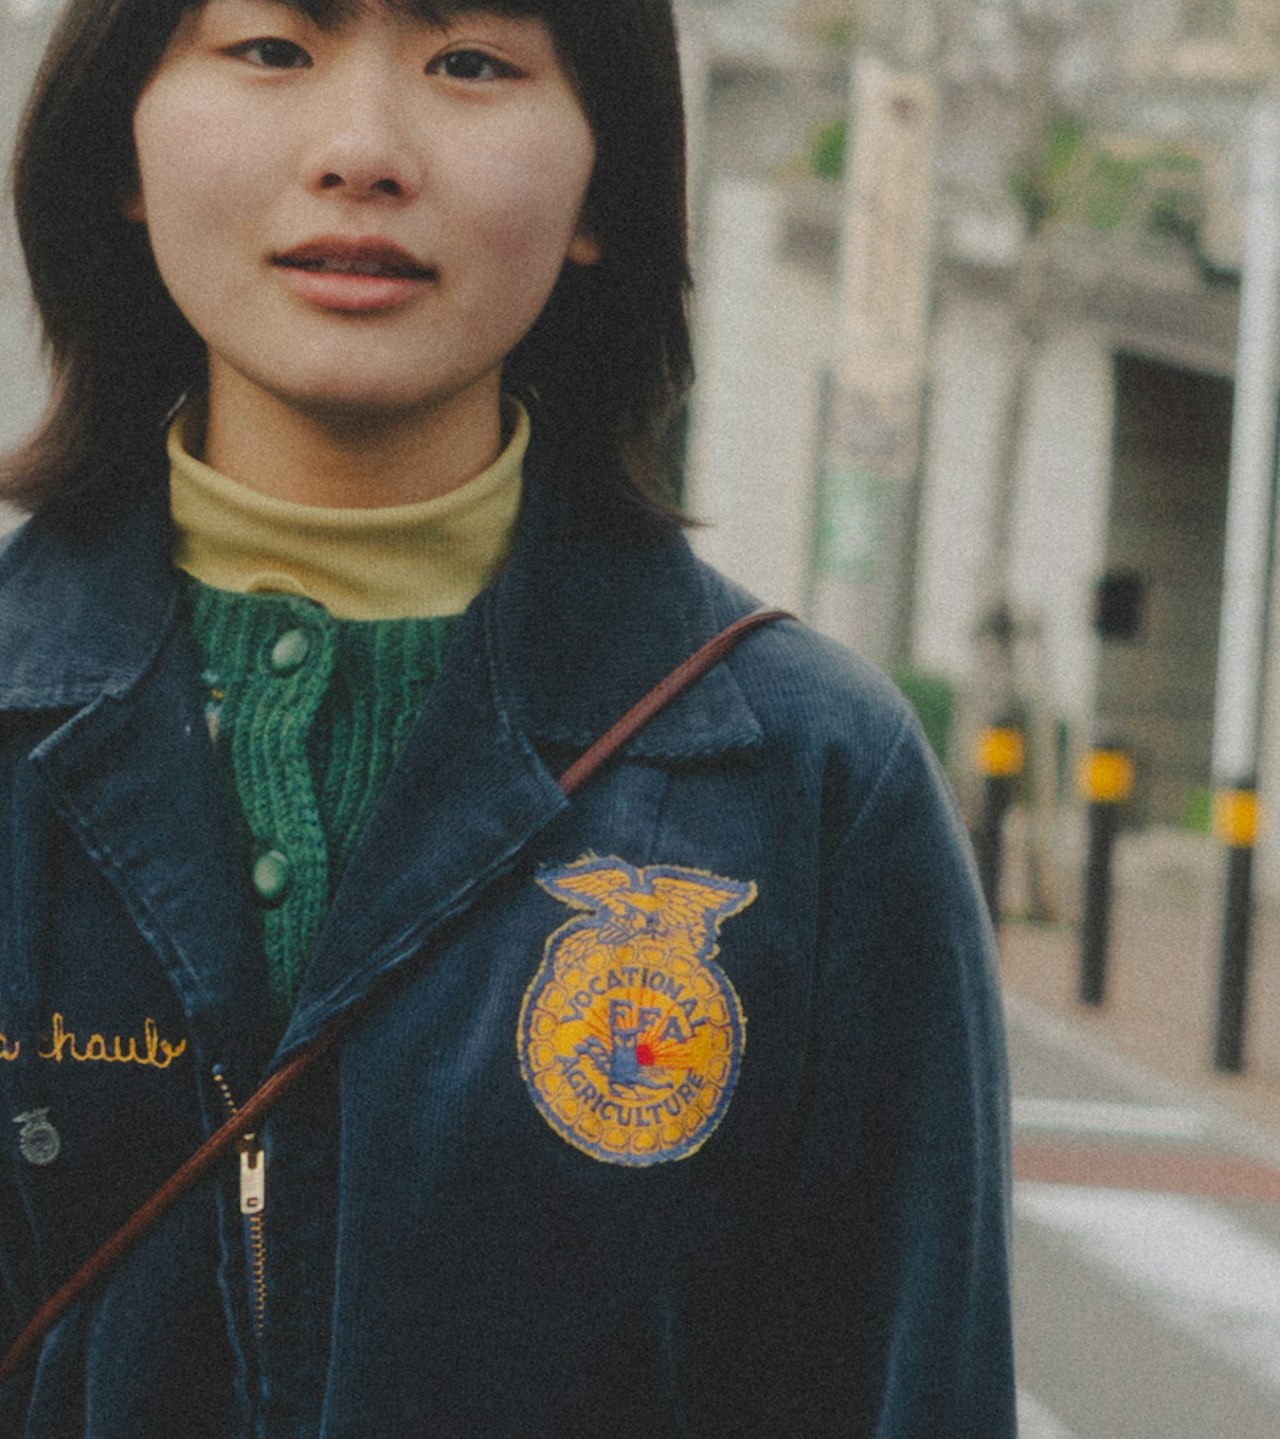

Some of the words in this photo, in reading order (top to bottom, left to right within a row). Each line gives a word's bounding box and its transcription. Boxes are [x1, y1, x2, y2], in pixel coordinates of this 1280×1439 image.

[561, 967, 711, 1037] VOCATIONAL
[609, 998, 687, 1044] FFA
[554, 1055, 704, 1127] AGRICULTURE
